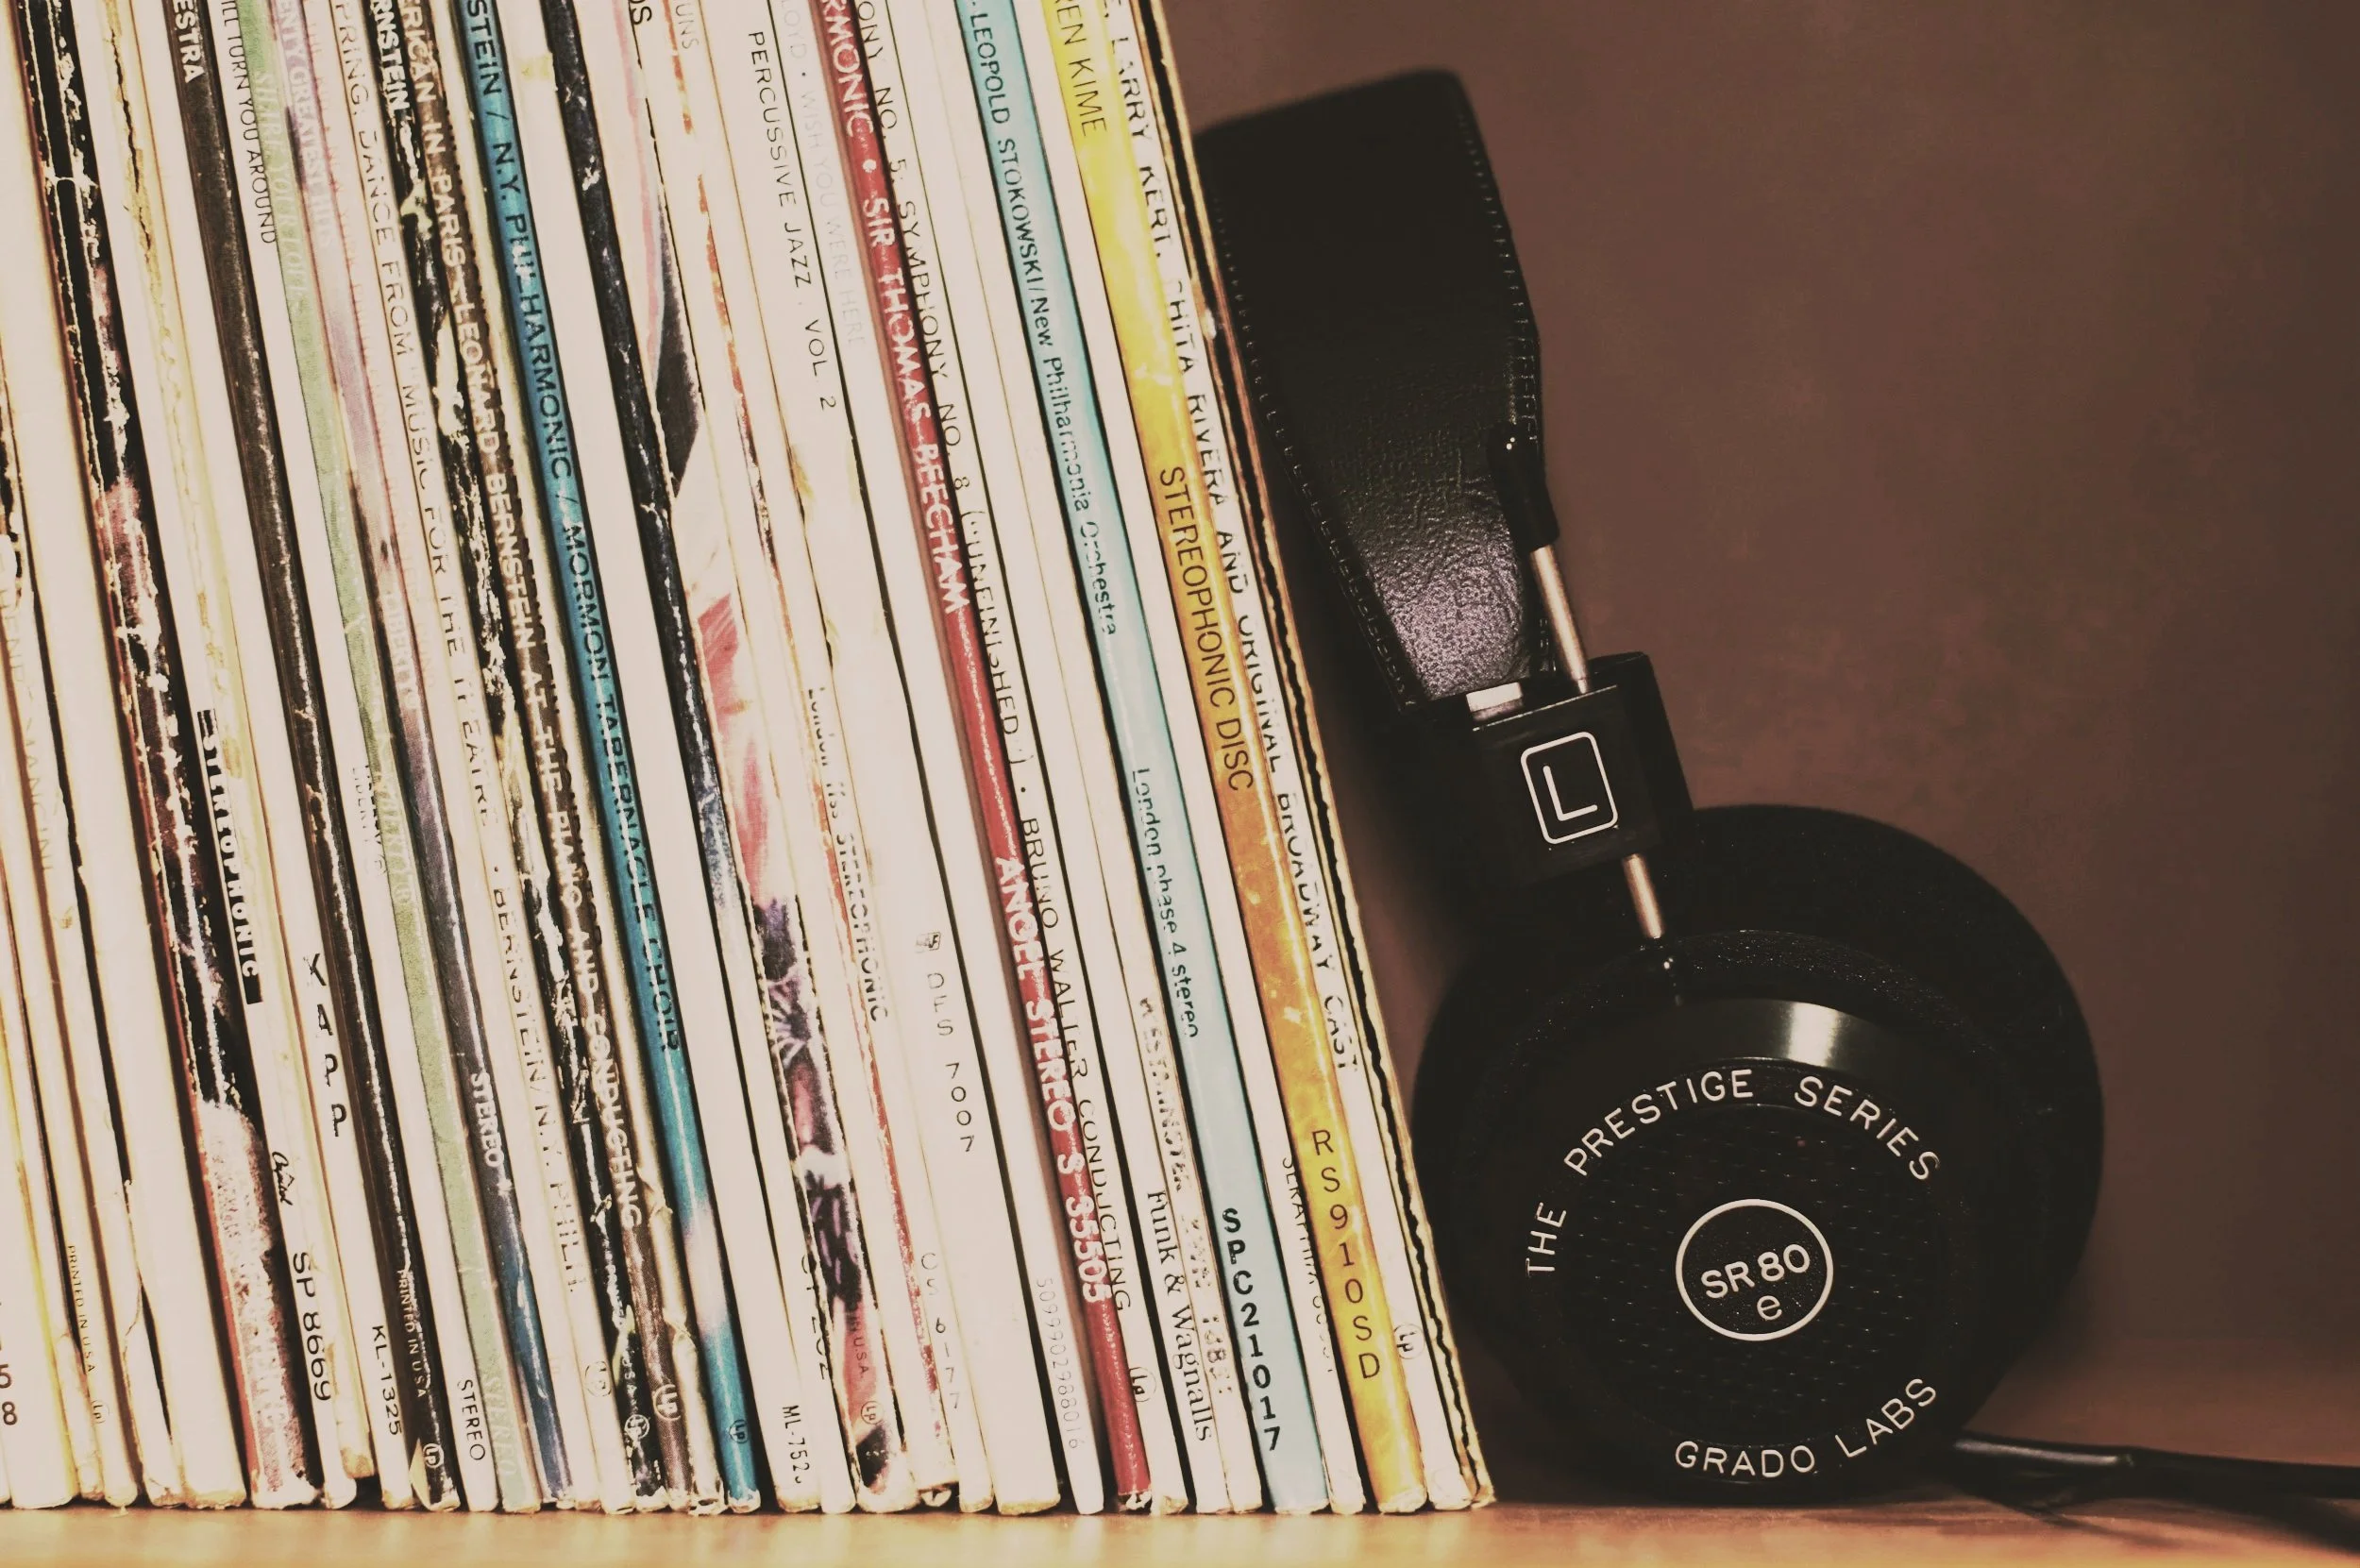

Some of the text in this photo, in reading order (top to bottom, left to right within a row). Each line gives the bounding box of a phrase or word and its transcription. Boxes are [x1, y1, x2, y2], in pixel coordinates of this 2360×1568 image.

[170, 0, 205, 83] ESTRA
[224, 32, 253, 91] TURN
[1054, 0, 1107, 137] EN KIME
[234, 92, 261, 143] YOU
[419, 121, 446, 156] IN
[244, 147, 278, 245] AROUND
[426, 172, 469, 269] PARIS
[746, 30, 797, 209] PERCUSSIVE
[818, 394, 836, 412] 2
[861, 194, 897, 248] SIR
[875, 268, 933, 424] THOMAS
[970, 12, 1011, 125] LEOPOLD
[1041, 356, 1093, 513] Philharmonia
[1077, 520, 1121, 636] Orchestra
[379, 260, 416, 357] FROM
[422, 504, 452, 574] FOR
[450, 300, 501, 457] LEONARD
[464, 0, 503, 97] STEIN
[502, 211, 572, 481] PHILHARMONIC
[562, 524, 610, 682] MORMON
[594, 694, 657, 925] TABERNACLE
[639, 936, 680, 1054] CHOIR
[483, 470, 537, 651] BERNSTEIN
[910, 442, 970, 614] BEECHAM
[854, 0, 885, 65] ONY
[895, 200, 950, 380] SYMPHONY
[952, 475, 970, 491] 8
[1020, 818, 1059, 929] BRUNO
[1045, 950, 1089, 1079] WALTER
[1074, 1097, 1132, 1312] CONDUCTING
[1157, 465, 1255, 793] STEREOPHONIC DISC
[518, 666, 548, 711] AT
[1187, 392, 1230, 507] RIVERA
[1216, 528, 1249, 595] AND
[1323, 993, 1358, 1076] CAST
[530, 725, 565, 793] THE
[1542, 765, 1598, 821] L
[200, 733, 261, 978] STEREOPHONIC
[546, 808, 583, 910] PIANO
[1130, 767, 1167, 856] London
[565, 925, 601, 996] AND
[1166, 940, 1187, 957] 4
[301, 952, 352, 1138] KAPP
[1170, 962, 1205, 1039] stereo
[469, 1071, 506, 1169] STEREO
[582, 1011, 643, 1231] CONDUCTING
[942, 1061, 978, 1154] 7007
[993, 851, 1112, 1305] ANGEL STEREO S 35505
[1525, 1069, 1940, 1275] THE PRESTIGE SERIES
[66, 1244, 85, 1307] PRINTED
[76, 1313, 89, 1330] IN
[289, 1250, 337, 1403] SP 8669
[396, 1268, 416, 1333] PRINTED
[406, 1338, 418, 1355] IN
[1144, 1189, 1218, 1443] Funk & Wagnalls
[1756, 1294, 1782, 1321] e
[369, 1324, 403, 1437] KL-1325
[455, 1378, 487, 1462] STEREO
[480, 1373, 521, 1479] STEREO
[1675, 1378, 1937, 1478] GRADO LABS
